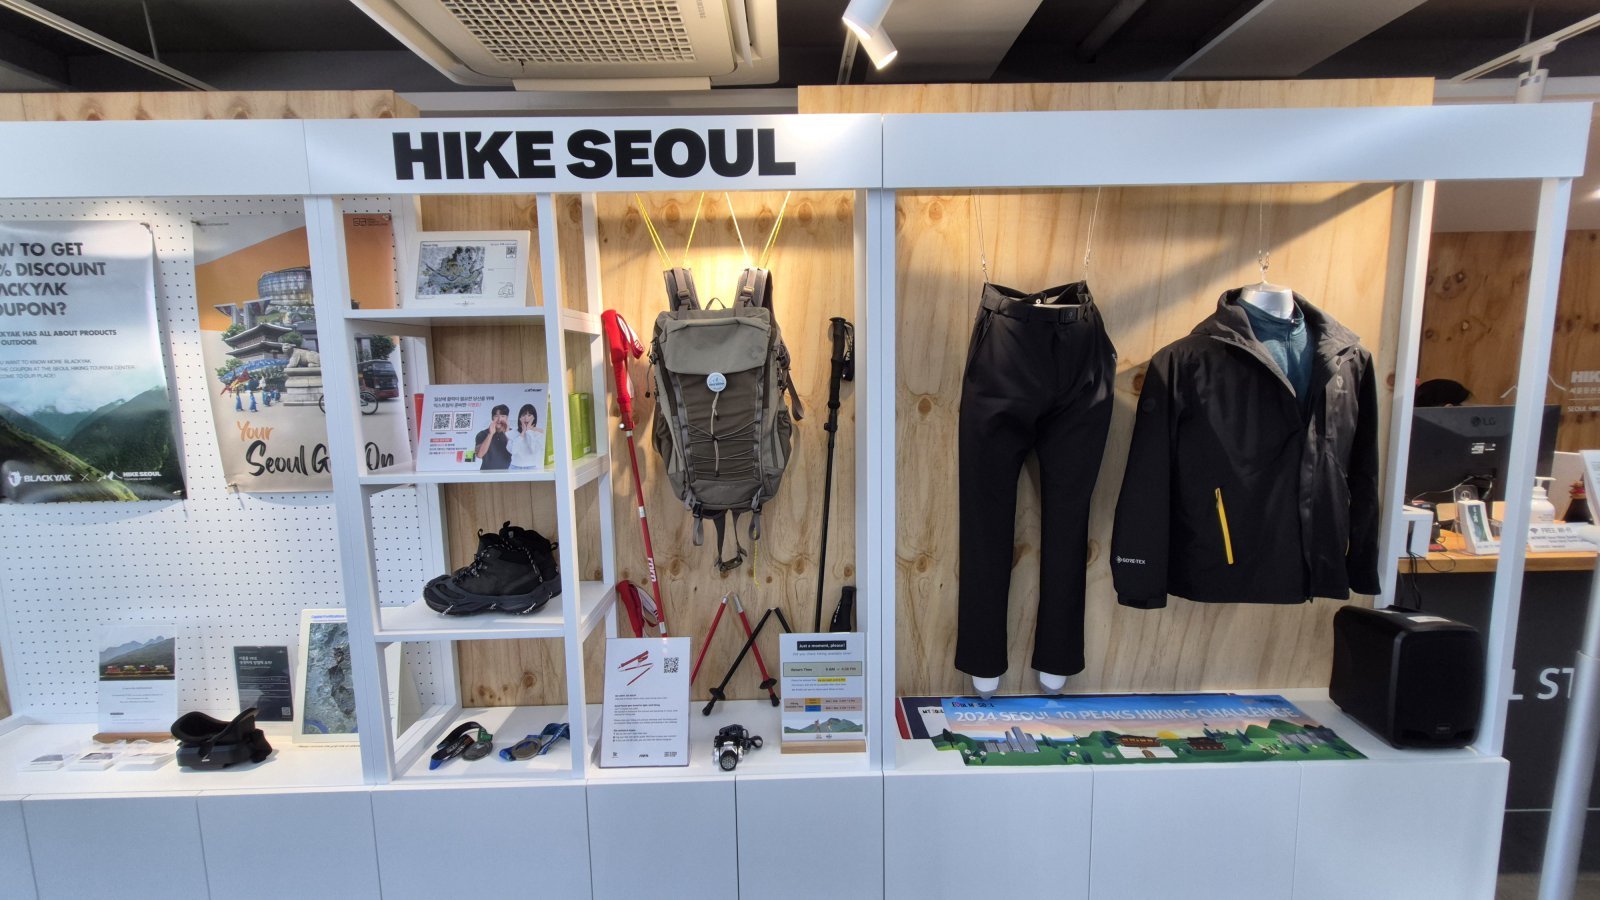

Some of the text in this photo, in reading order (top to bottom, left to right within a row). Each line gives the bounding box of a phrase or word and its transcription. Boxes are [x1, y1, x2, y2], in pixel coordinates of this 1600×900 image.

[392, 128, 796, 180] HIKE SEOUL
[20, 243, 45, 256] TO
[51, 242, 83, 256] GET
[15, 262, 106, 276] DISCOUNT
[236, 420, 273, 442] Your
[246, 440, 308, 476] Seoul
[954, 711, 998, 722] 2024
[1079, 710, 1137, 721] PEAKS
[1138, 708, 1198, 720] HIKING
